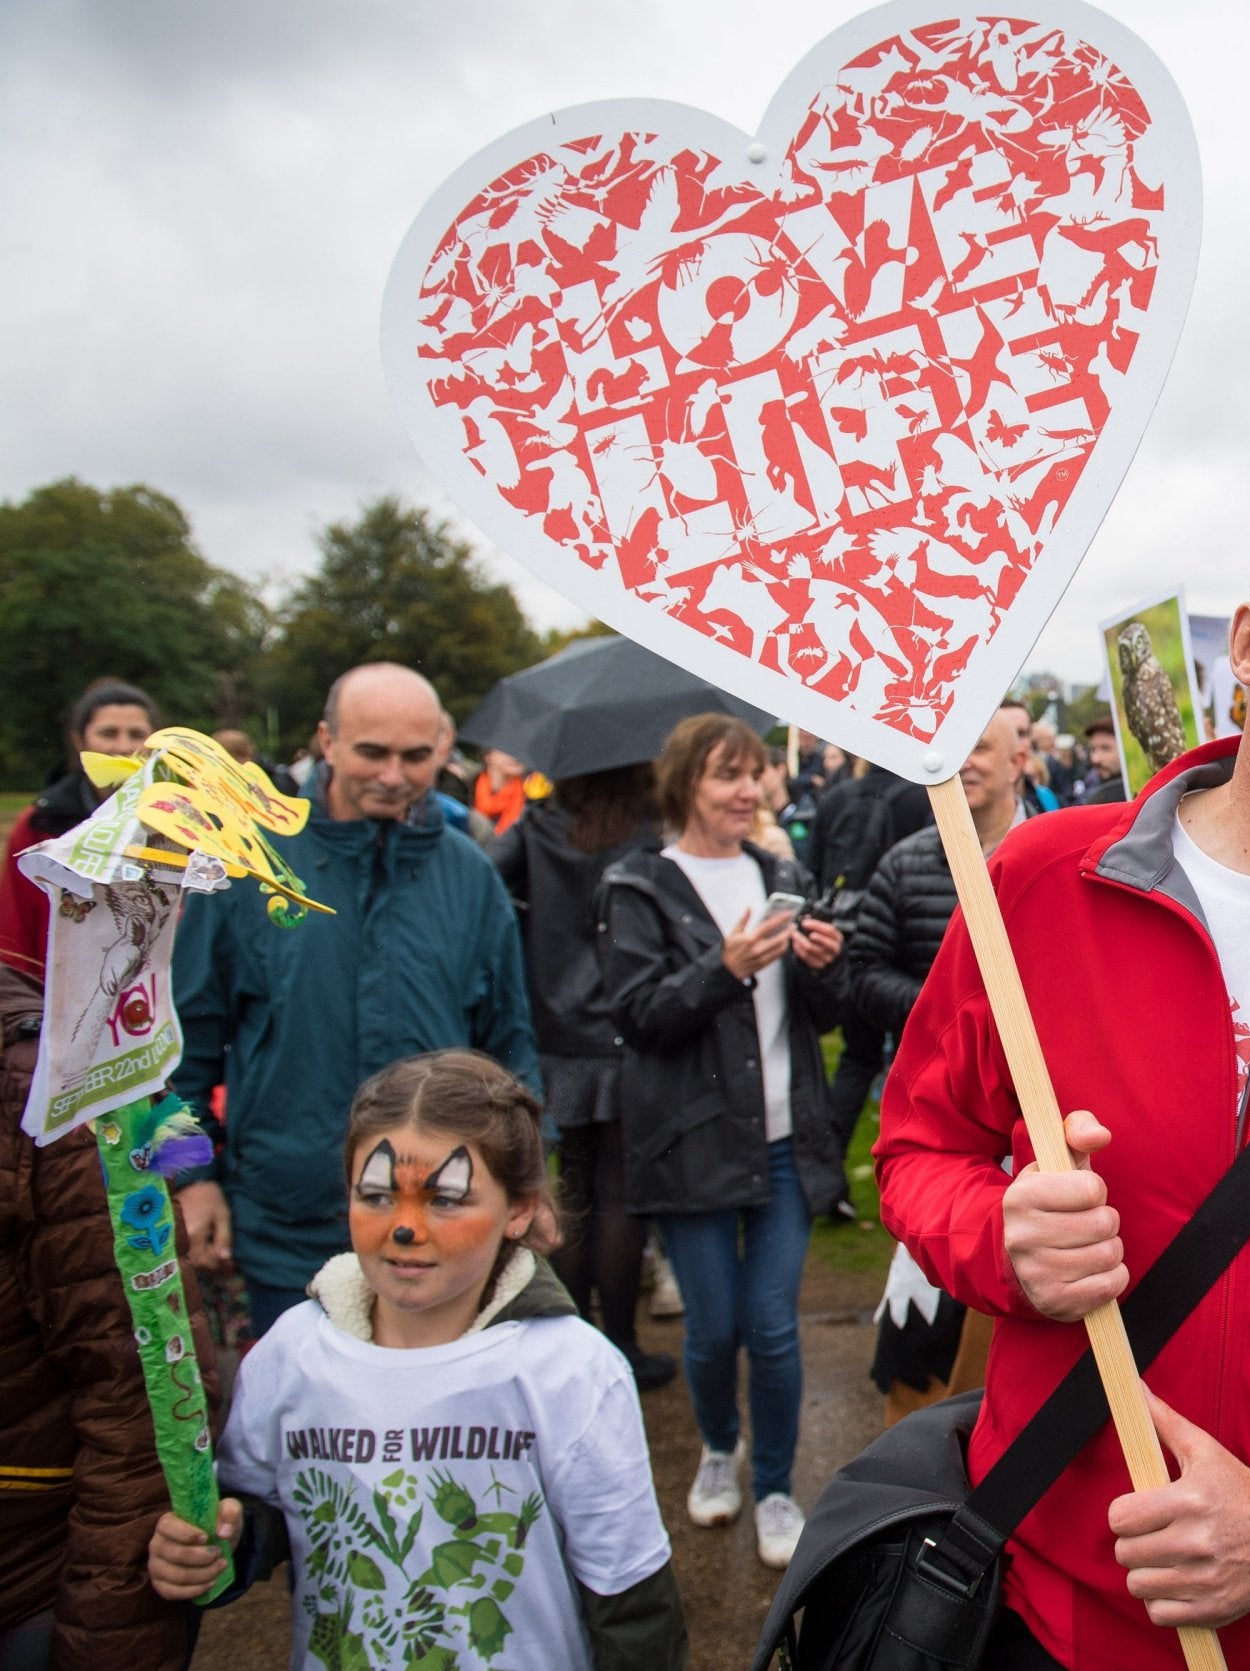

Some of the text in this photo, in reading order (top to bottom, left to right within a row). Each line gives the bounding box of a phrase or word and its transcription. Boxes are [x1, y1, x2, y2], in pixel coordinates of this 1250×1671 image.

[549, 147, 1041, 416] LOVE
[584, 284, 1098, 588] LIFE
[286, 1427, 376, 1464] WALKED
[381, 1429, 404, 1463] FOR
